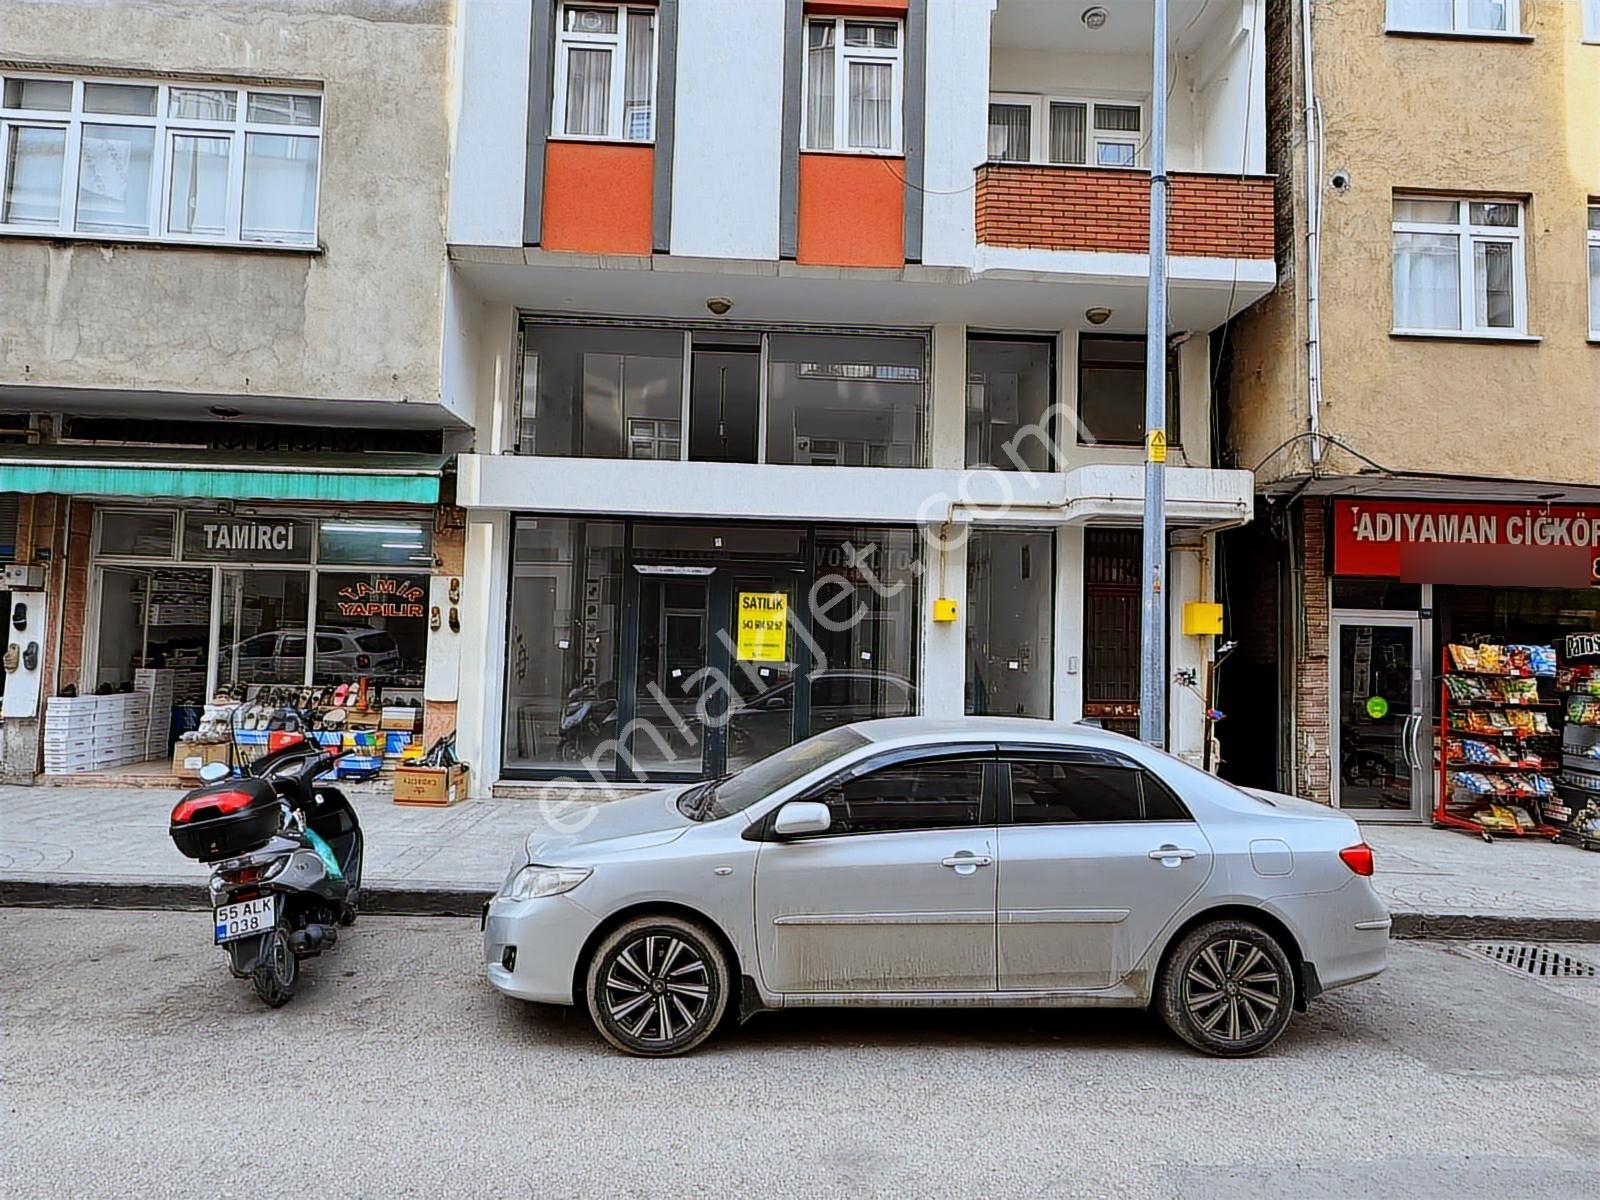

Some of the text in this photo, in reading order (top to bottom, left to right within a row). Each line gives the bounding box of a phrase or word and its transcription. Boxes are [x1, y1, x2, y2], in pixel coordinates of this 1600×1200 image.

[203, 522, 293, 550] TAMİRCİ
[1356, 512, 1497, 544] ADIYAMAN
[338, 578, 424, 602] TAMİR
[338, 603, 424, 617] YAPILIR
[742, 596, 783, 610] SATILIK
[219, 898, 271, 922] 55 ALK
[229, 916, 259, 934] 038
